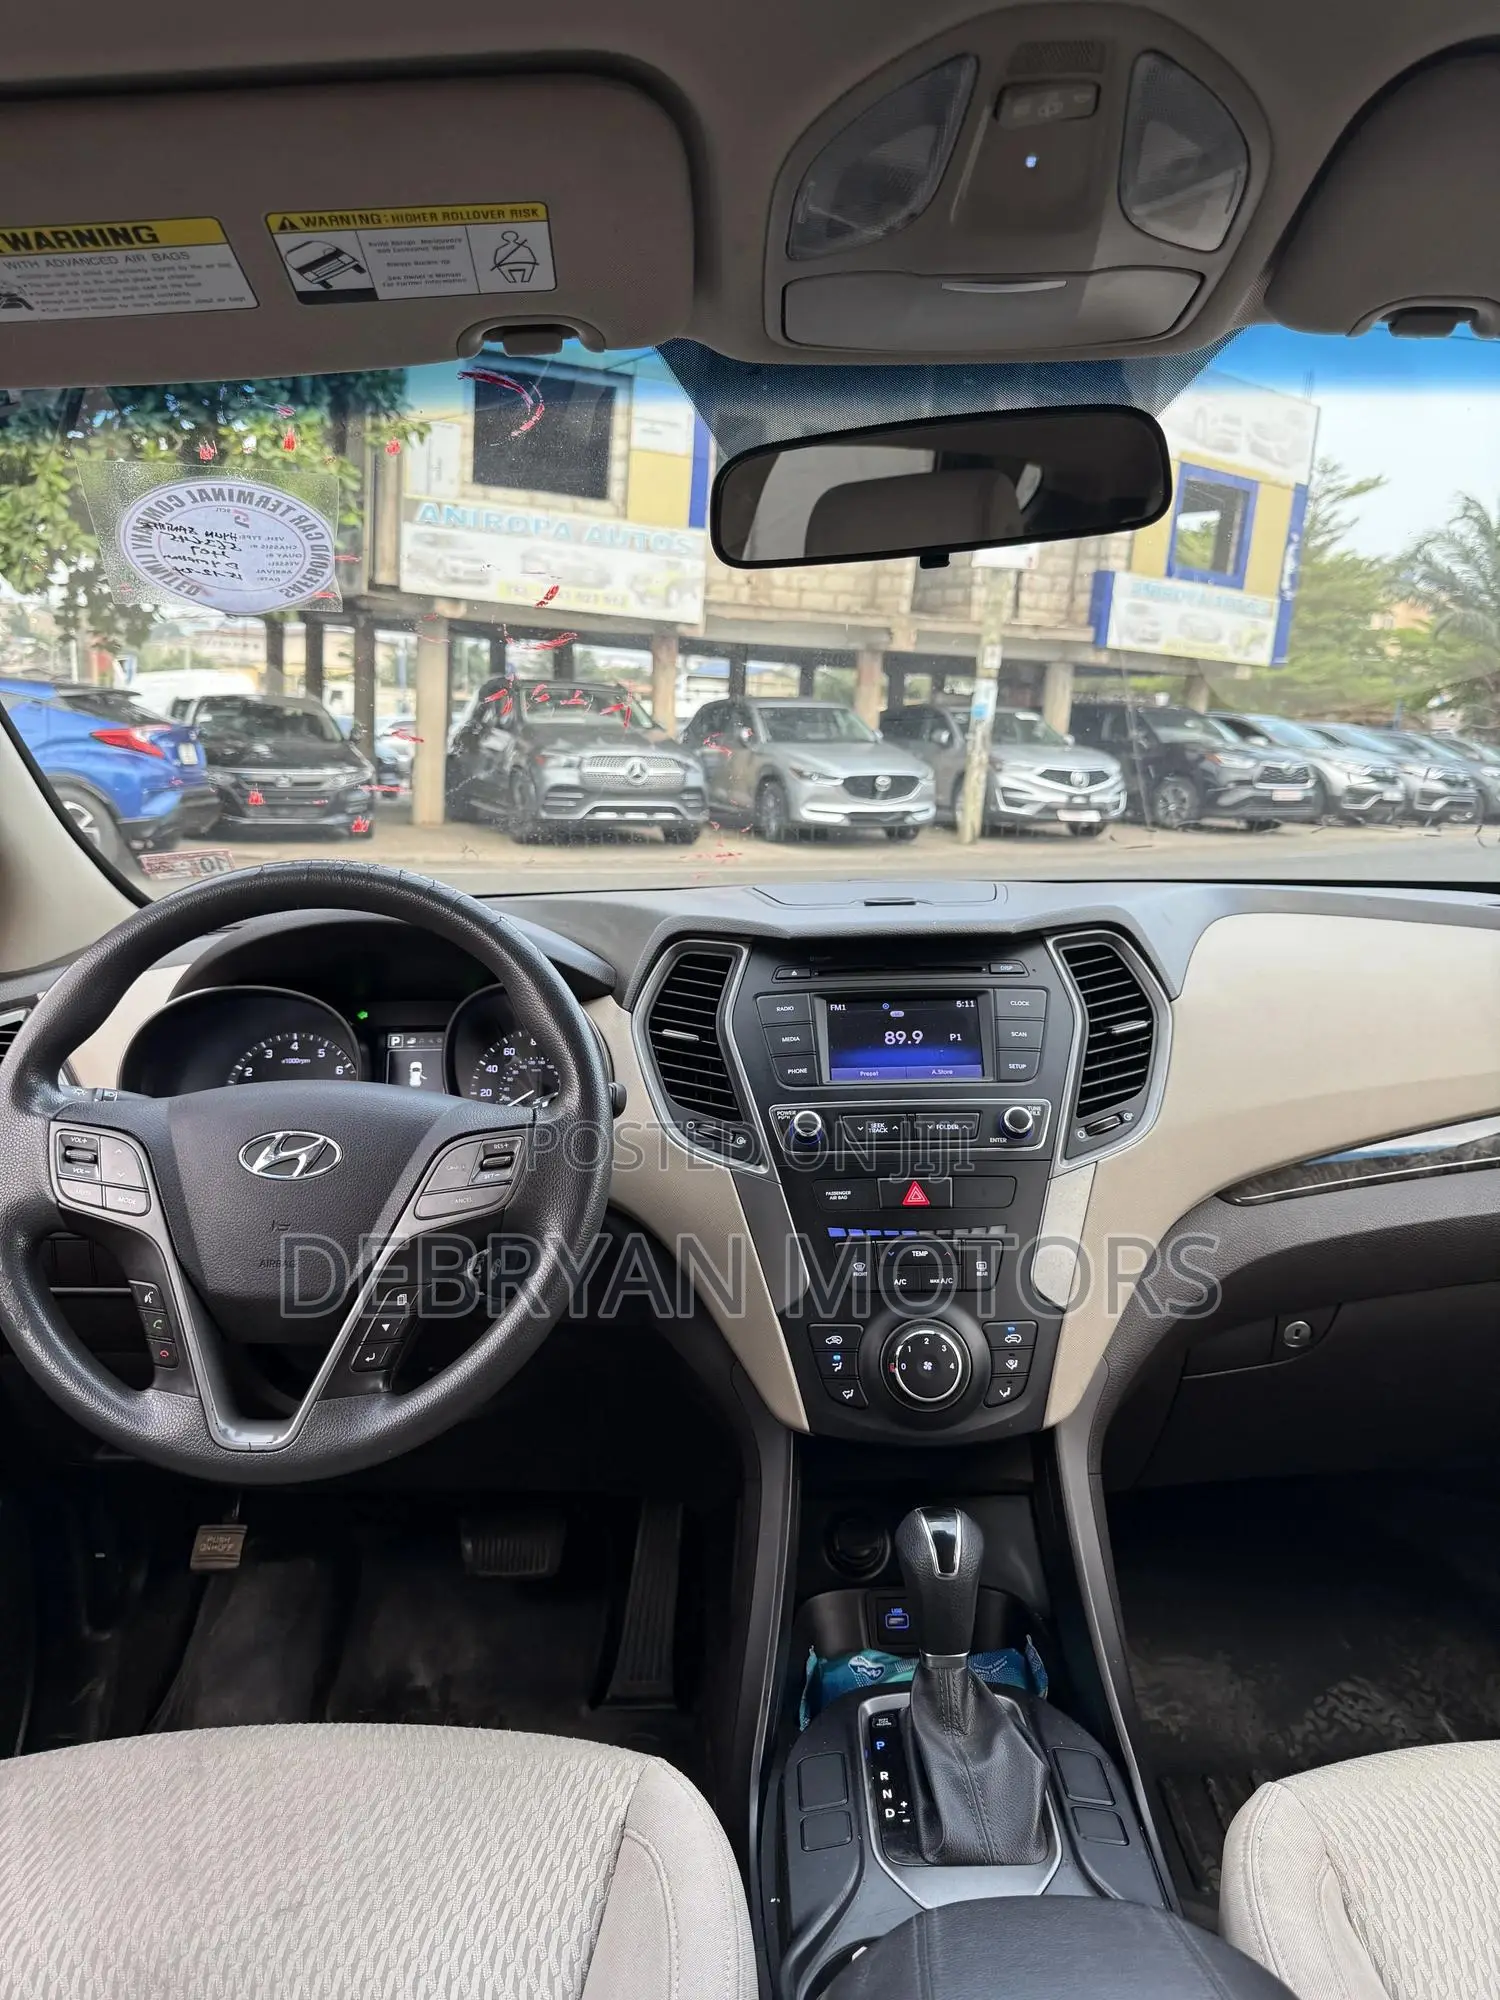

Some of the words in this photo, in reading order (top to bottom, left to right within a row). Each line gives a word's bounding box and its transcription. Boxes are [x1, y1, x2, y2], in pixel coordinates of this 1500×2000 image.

[391, 212, 438, 224] HIGHER
[442, 209, 506, 222] ROLLOVER
[510, 208, 540, 218] RISK
[1, 225, 161, 251] WARNING
[3, 259, 39, 271] WITH
[44, 255, 118, 269] ADVANCED
[124, 254, 147, 264] AIR
[152, 251, 190, 262] BAGS
[583, 524, 695, 556] AUTOS
[830, 1003, 847, 1012] FM1
[956, 1000, 975, 1009] 5:11
[391, 1036, 401, 1046] P
[884, 1030, 924, 1045] 89.9
[949, 1033, 962, 1041] P1
[290, 1041, 299, 1051] 4
[264, 1049, 273, 1059] 3
[317, 1048, 326, 1058] 5
[503, 1047, 515, 1056] 60
[244, 1067, 253, 1077] 2
[335, 1066, 344, 1075] 6
[485, 1064, 499, 1073] 40
[787, 1067, 808, 1075] PHONE
[480, 1088, 492, 1097] 20
[894, 1278, 907, 1286] A/C
[924, 1337, 930, 1345] 2
[875, 1741, 885, 1750] P
[880, 1771, 889, 1781] R
[882, 1789, 892, 1799] N
[885, 1808, 895, 1818] D
